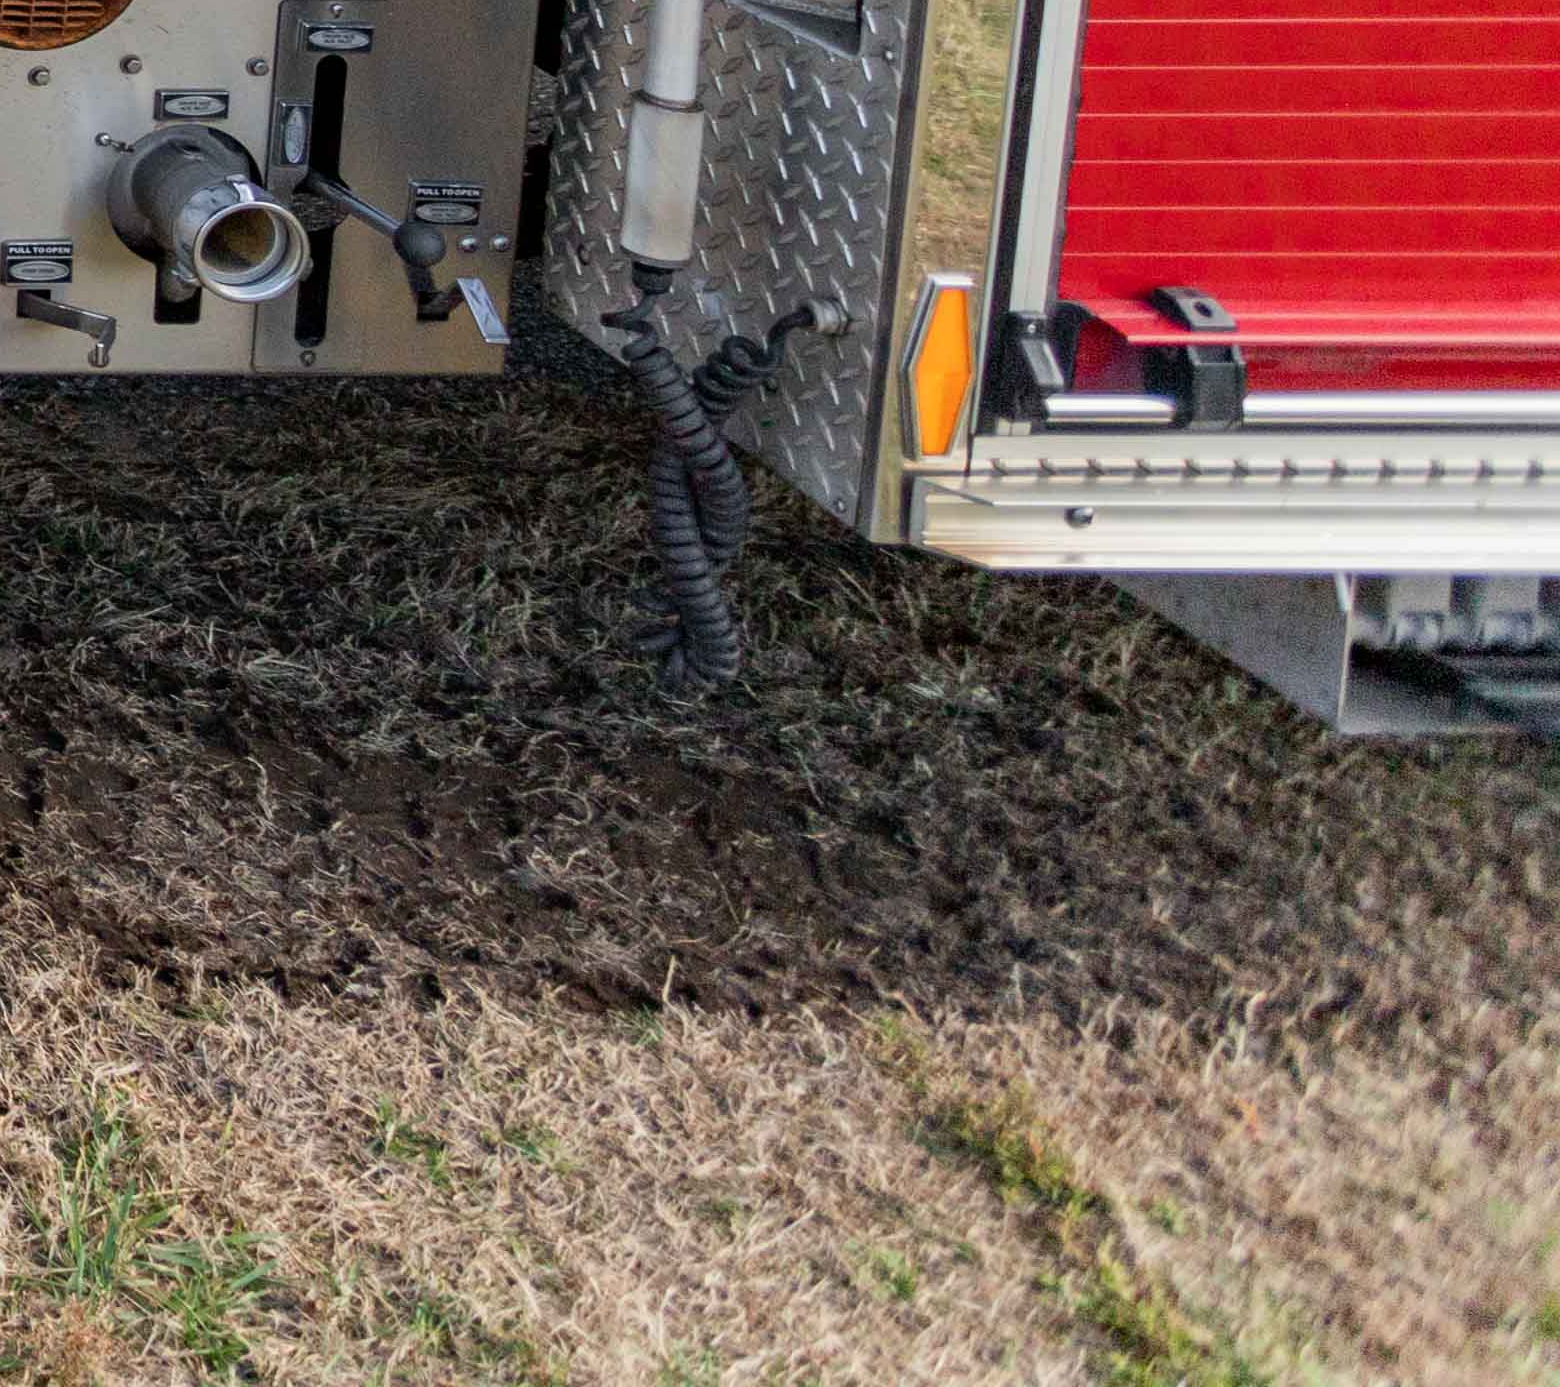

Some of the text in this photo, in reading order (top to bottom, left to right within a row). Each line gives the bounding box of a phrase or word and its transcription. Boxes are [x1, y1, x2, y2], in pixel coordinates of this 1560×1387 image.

[416, 188, 440, 196] PULL
[454, 188, 480, 196] OPEN
[8, 246, 32, 254] PULL
[46, 246, 71, 254] OPEN
